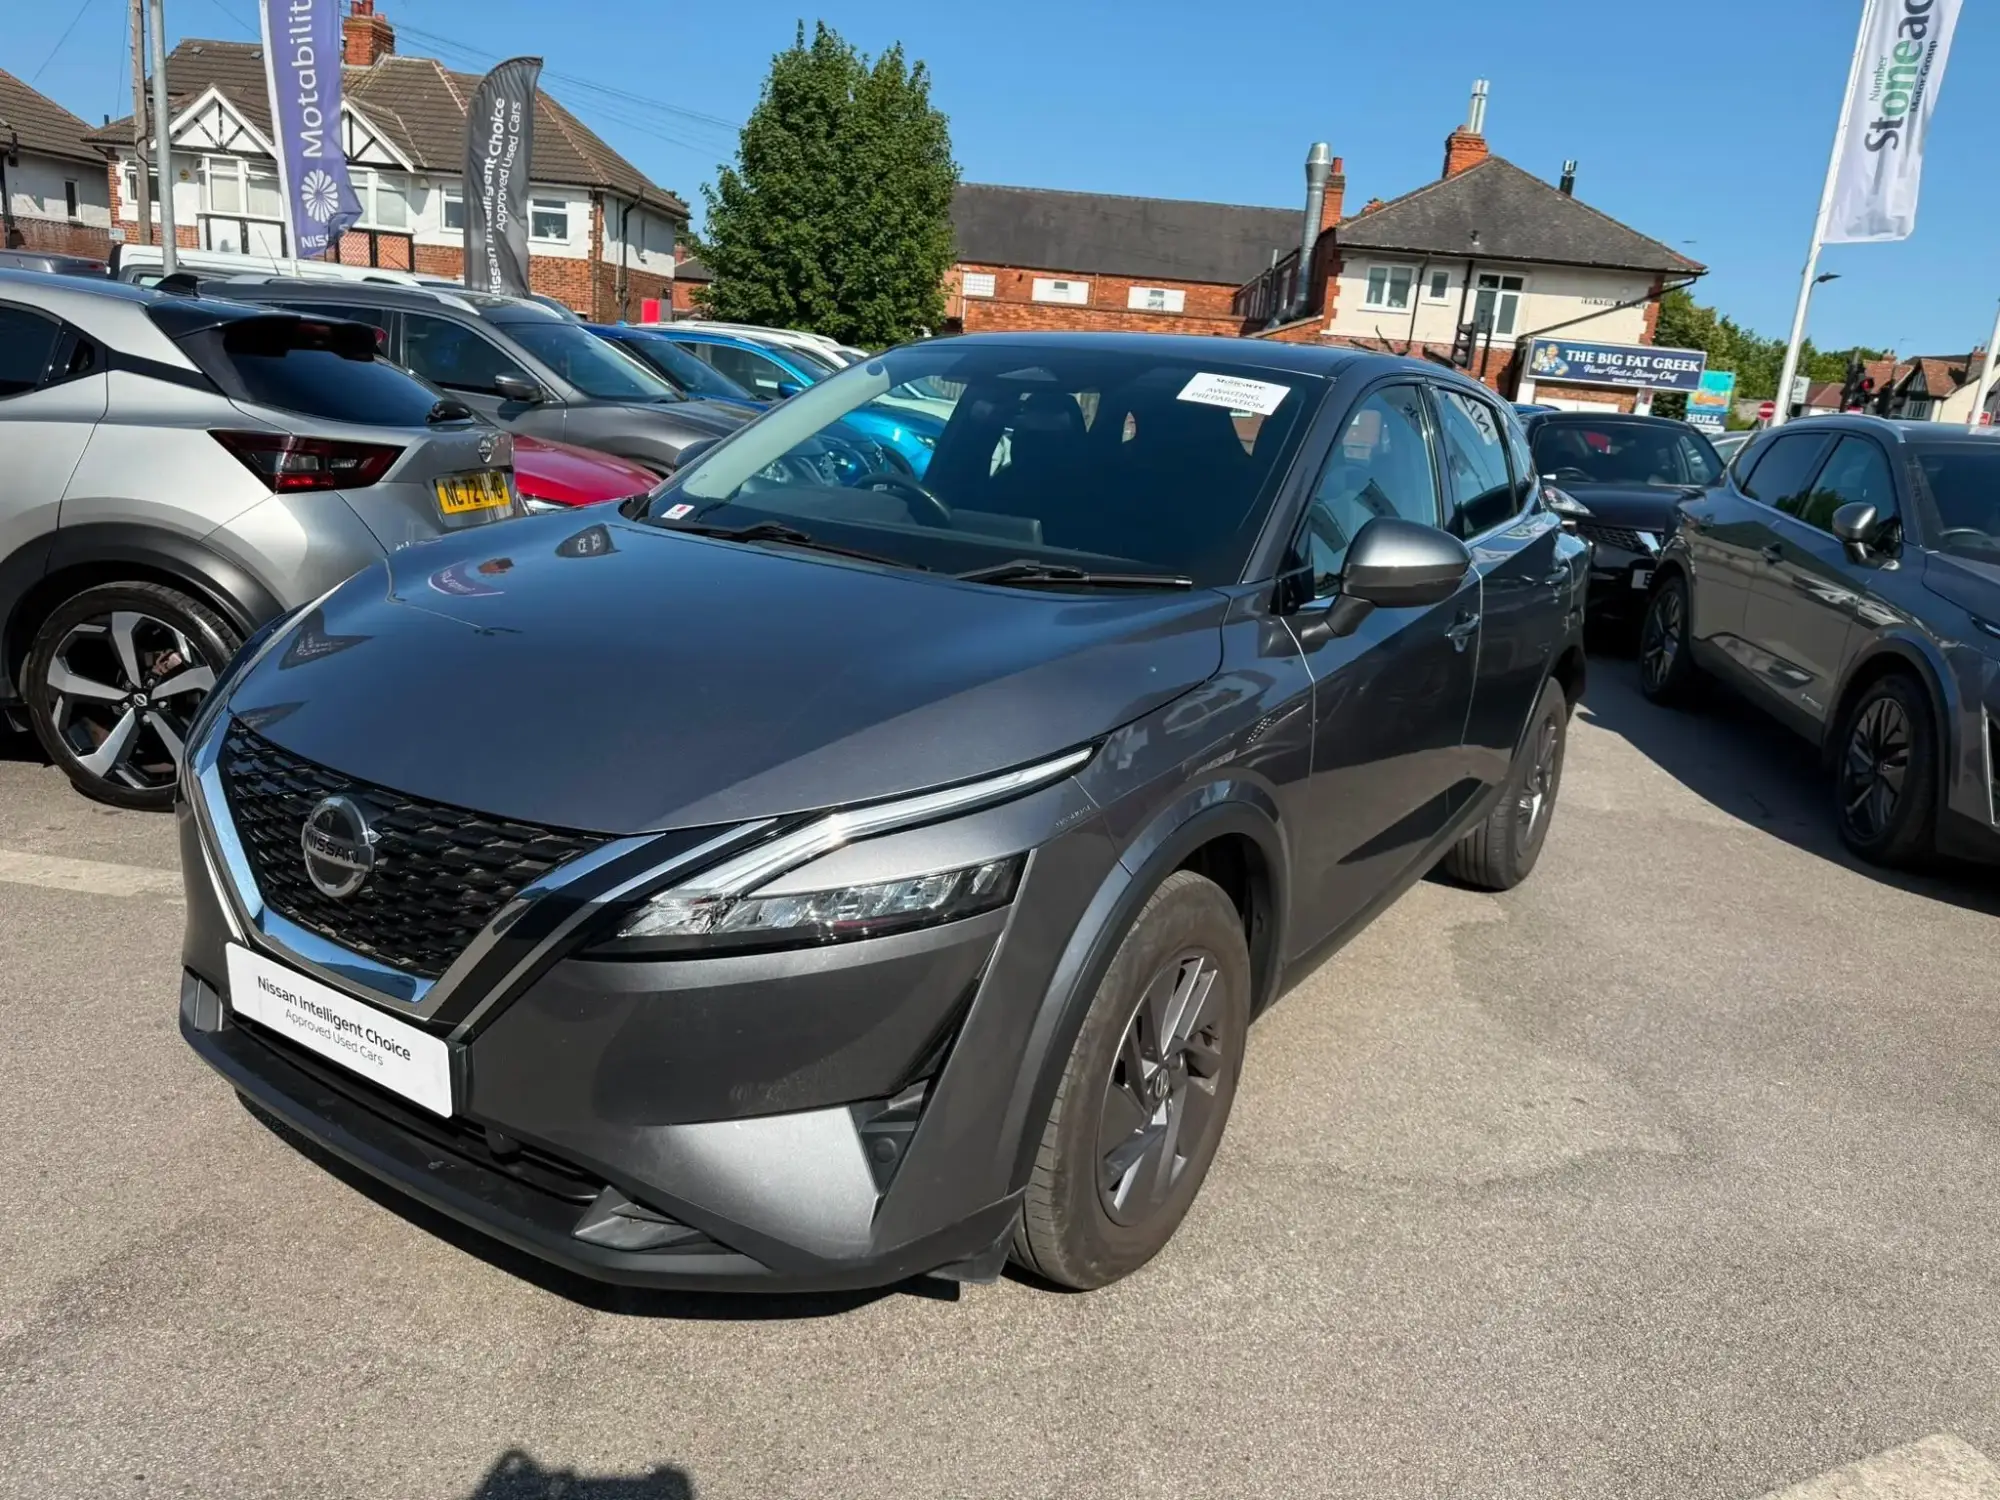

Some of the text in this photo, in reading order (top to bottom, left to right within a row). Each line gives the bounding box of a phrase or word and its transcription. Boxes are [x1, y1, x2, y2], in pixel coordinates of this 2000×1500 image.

[288, 0, 323, 158] Motabilit
[1864, 0, 1934, 152] Stoneac
[1869, 56, 1888, 101] Number
[1910, 40, 1938, 112] Motor Group
[488, 97, 505, 156] Choice
[496, 100, 521, 232] Approved Used Cars
[301, 234, 330, 248] NIS
[1565, 349, 1700, 372] THE BIG FAT GREEK
[1191, 391, 1265, 409] PREPARATION
[1205, 387, 1261, 401] AWAITING
[1686, 413, 1720, 424] HULL
[306, 832, 359, 863] NISSAN
[257, 975, 411, 1061] Nissan Intelligent Choice
[285, 1009, 384, 1066] Approved Used Cars
